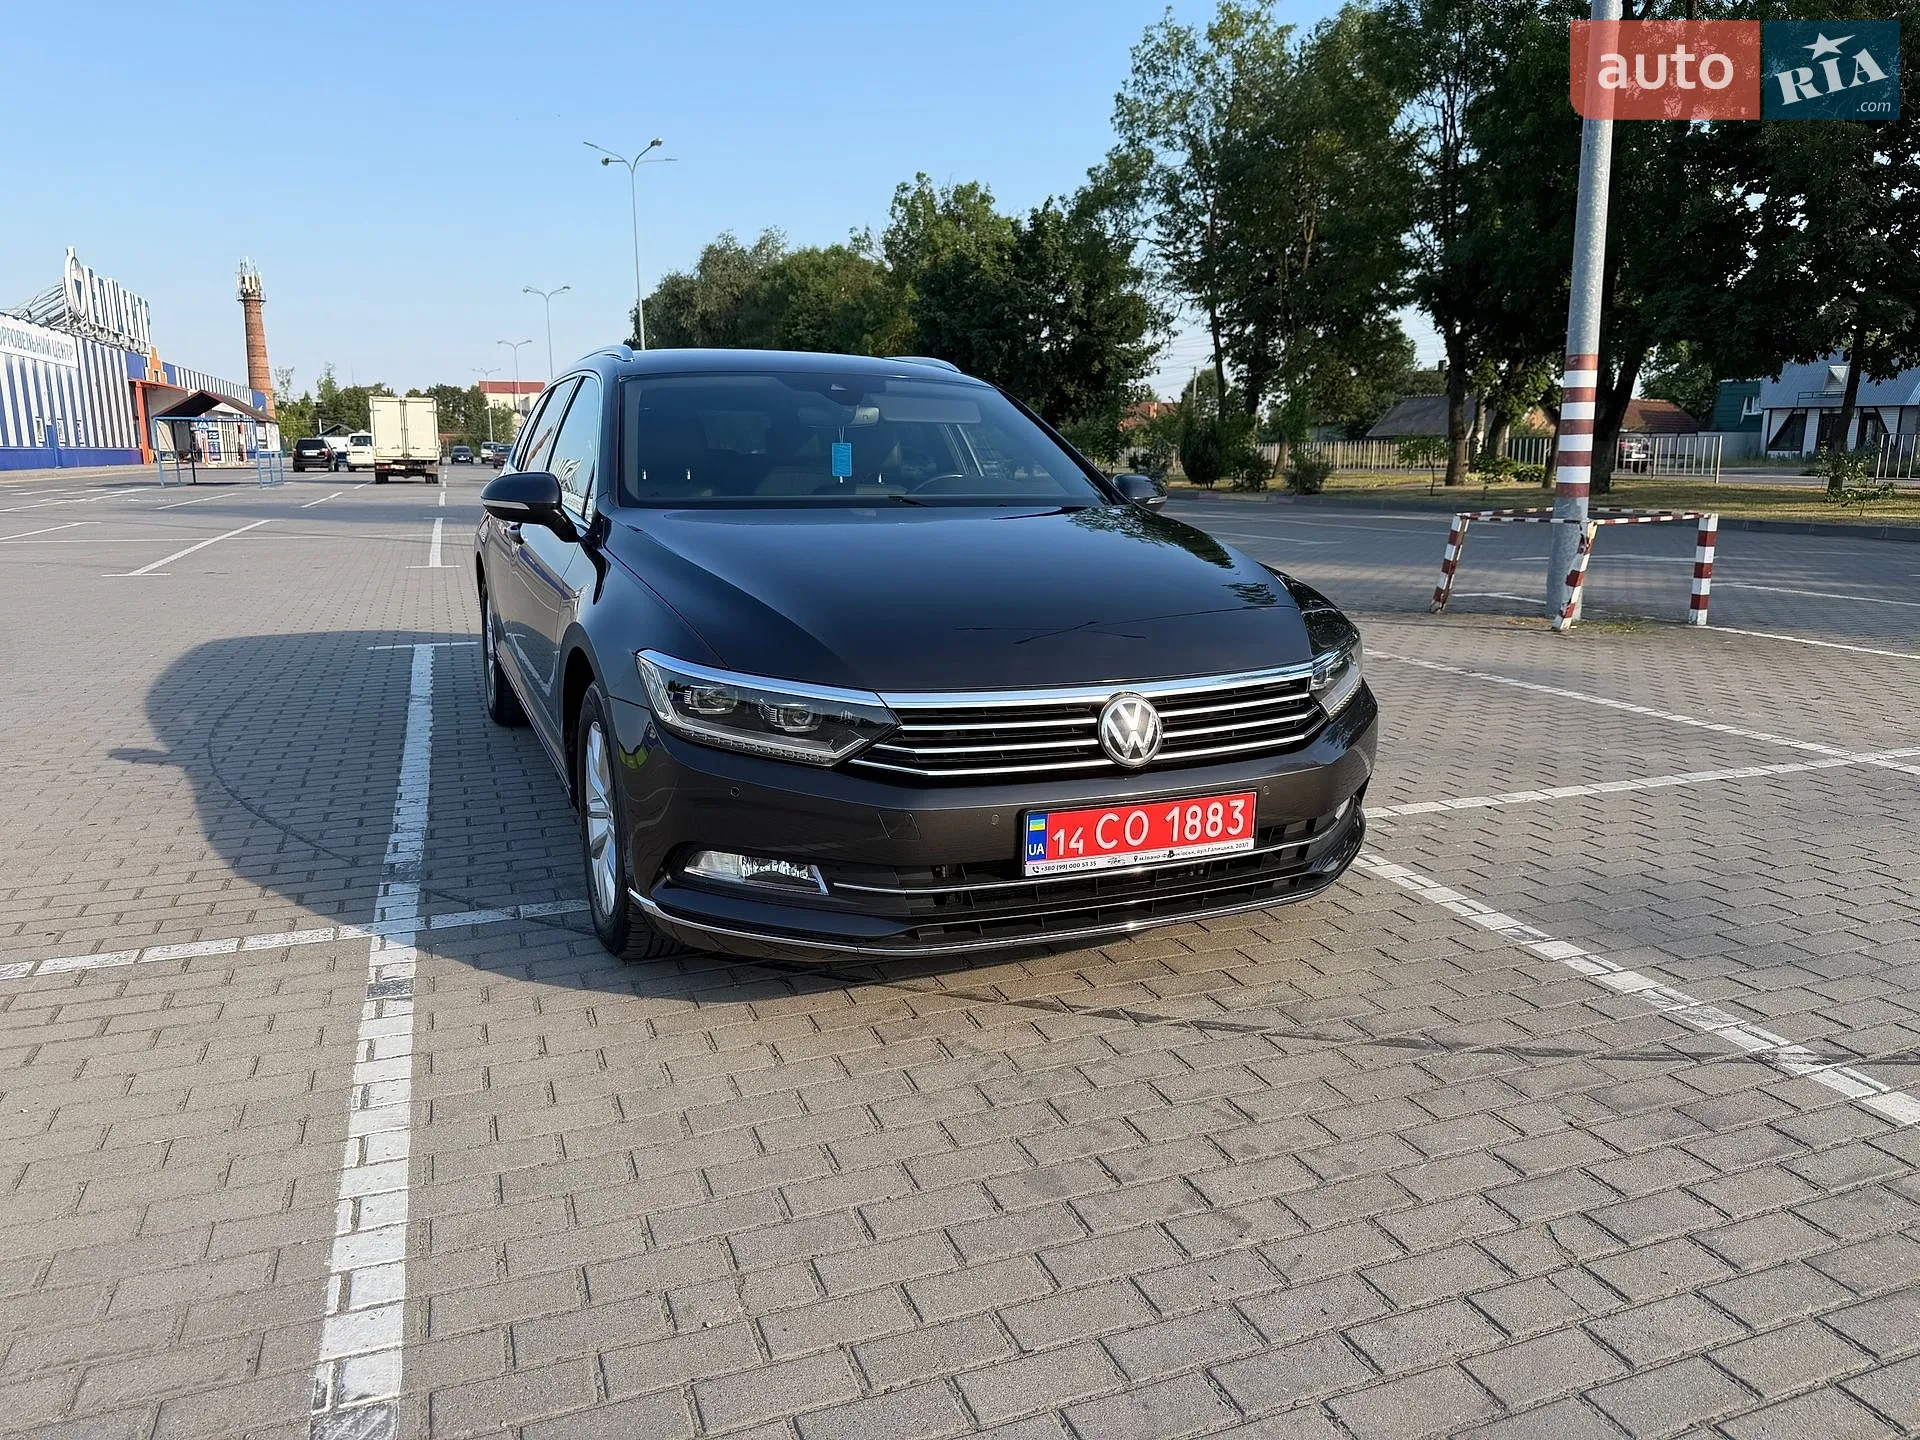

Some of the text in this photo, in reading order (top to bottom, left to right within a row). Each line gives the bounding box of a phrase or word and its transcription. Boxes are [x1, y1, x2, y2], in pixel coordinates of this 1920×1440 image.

[52, 340, 74, 361] ЦЕНТР
[1051, 799, 1246, 857] 14 CO 1883
[1028, 843, 1045, 856] UA
